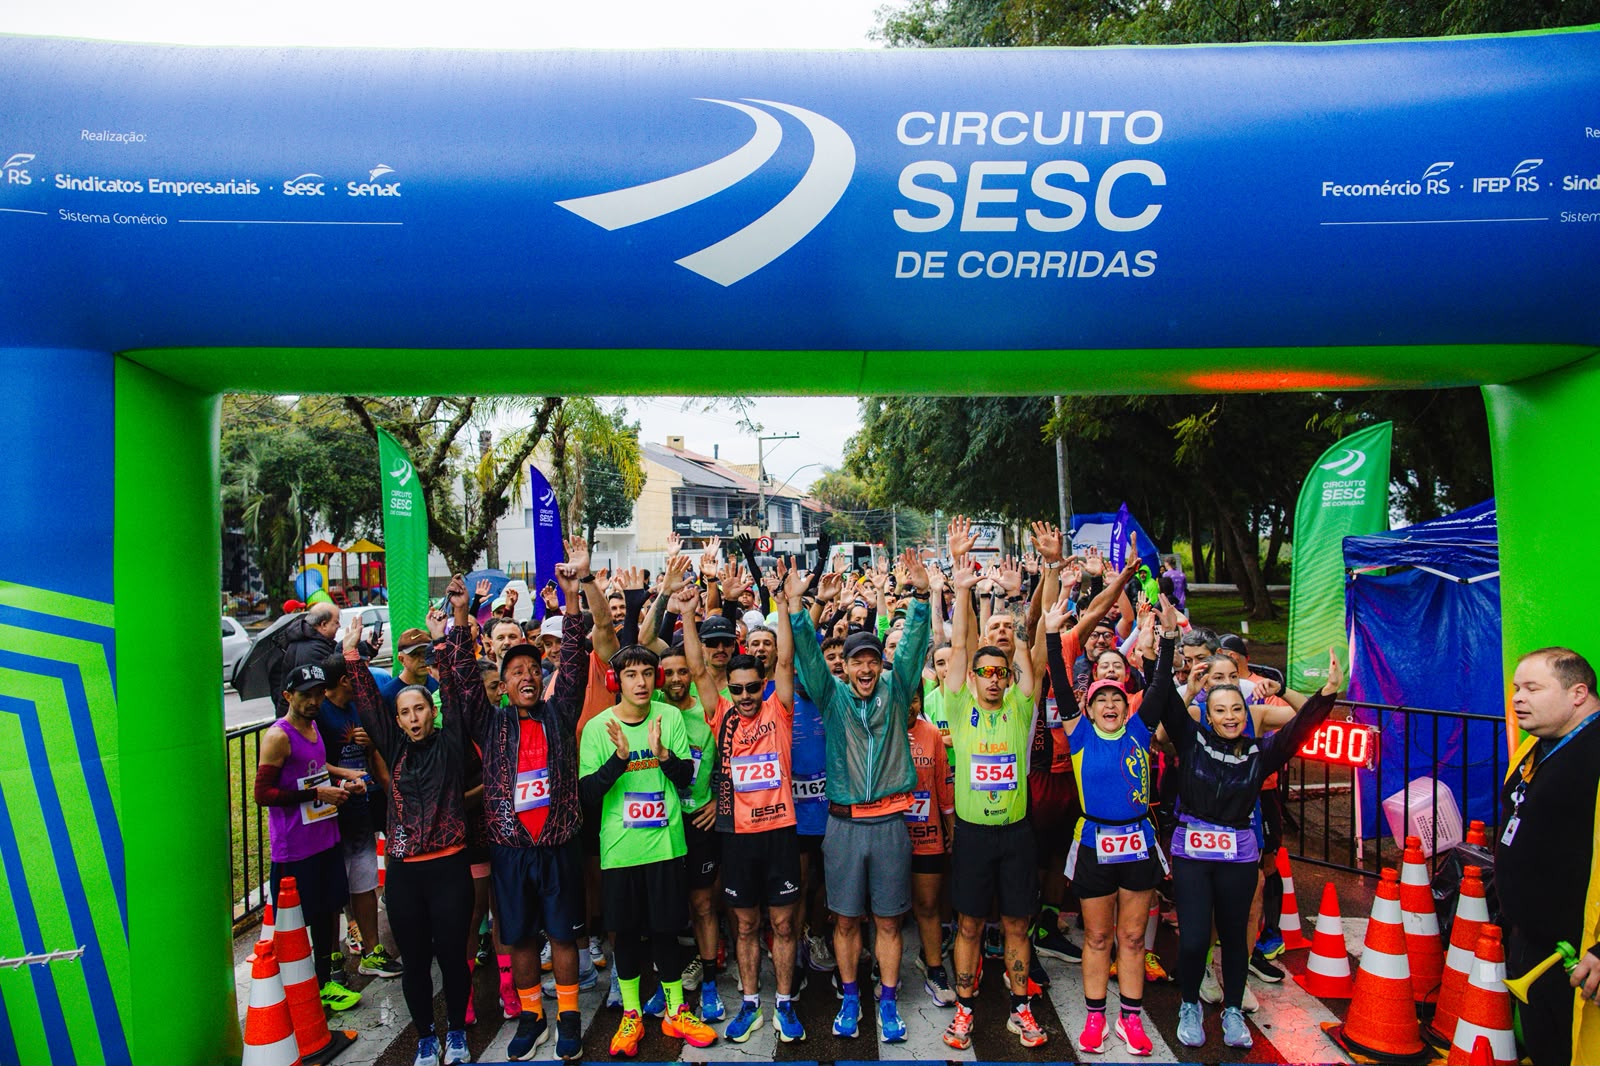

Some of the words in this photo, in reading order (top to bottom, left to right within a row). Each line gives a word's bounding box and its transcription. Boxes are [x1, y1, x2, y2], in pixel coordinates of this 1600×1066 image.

[81, 129, 147, 144] Realização:
[896, 110, 1164, 146] CIRCUITO
[8, 168, 32, 185] RS
[55, 174, 143, 193] Sindicatos
[149, 177, 260, 197] Empresariais
[283, 179, 325, 196] Sesc
[347, 179, 401, 197] Senac
[1321, 180, 1421, 197] Fecomércio
[1426, 178, 1450, 195] RS
[1472, 177, 1511, 193] IFEP
[1515, 175, 1539, 192] RS
[893, 159, 1167, 233] SESC
[58, 209, 110, 224] Sistema
[113, 211, 168, 226] Comércio
[895, 250, 948, 279] DE
[957, 250, 1158, 279] CORRIDAS
[1322, 480, 1366, 489] CIRCUITO
[1321, 487, 1366, 501] SESC
[390, 497, 413, 511] SESC
[735, 762, 776, 782] 728
[975, 764, 1015, 781] 554
[791, 780, 827, 795] 1162
[723, 780, 732, 815] SEXTO
[628, 801, 666, 819] 602
[751, 802, 787, 818] IESA
[1101, 833, 1142, 853] 676
[1189, 831, 1232, 850] 636
